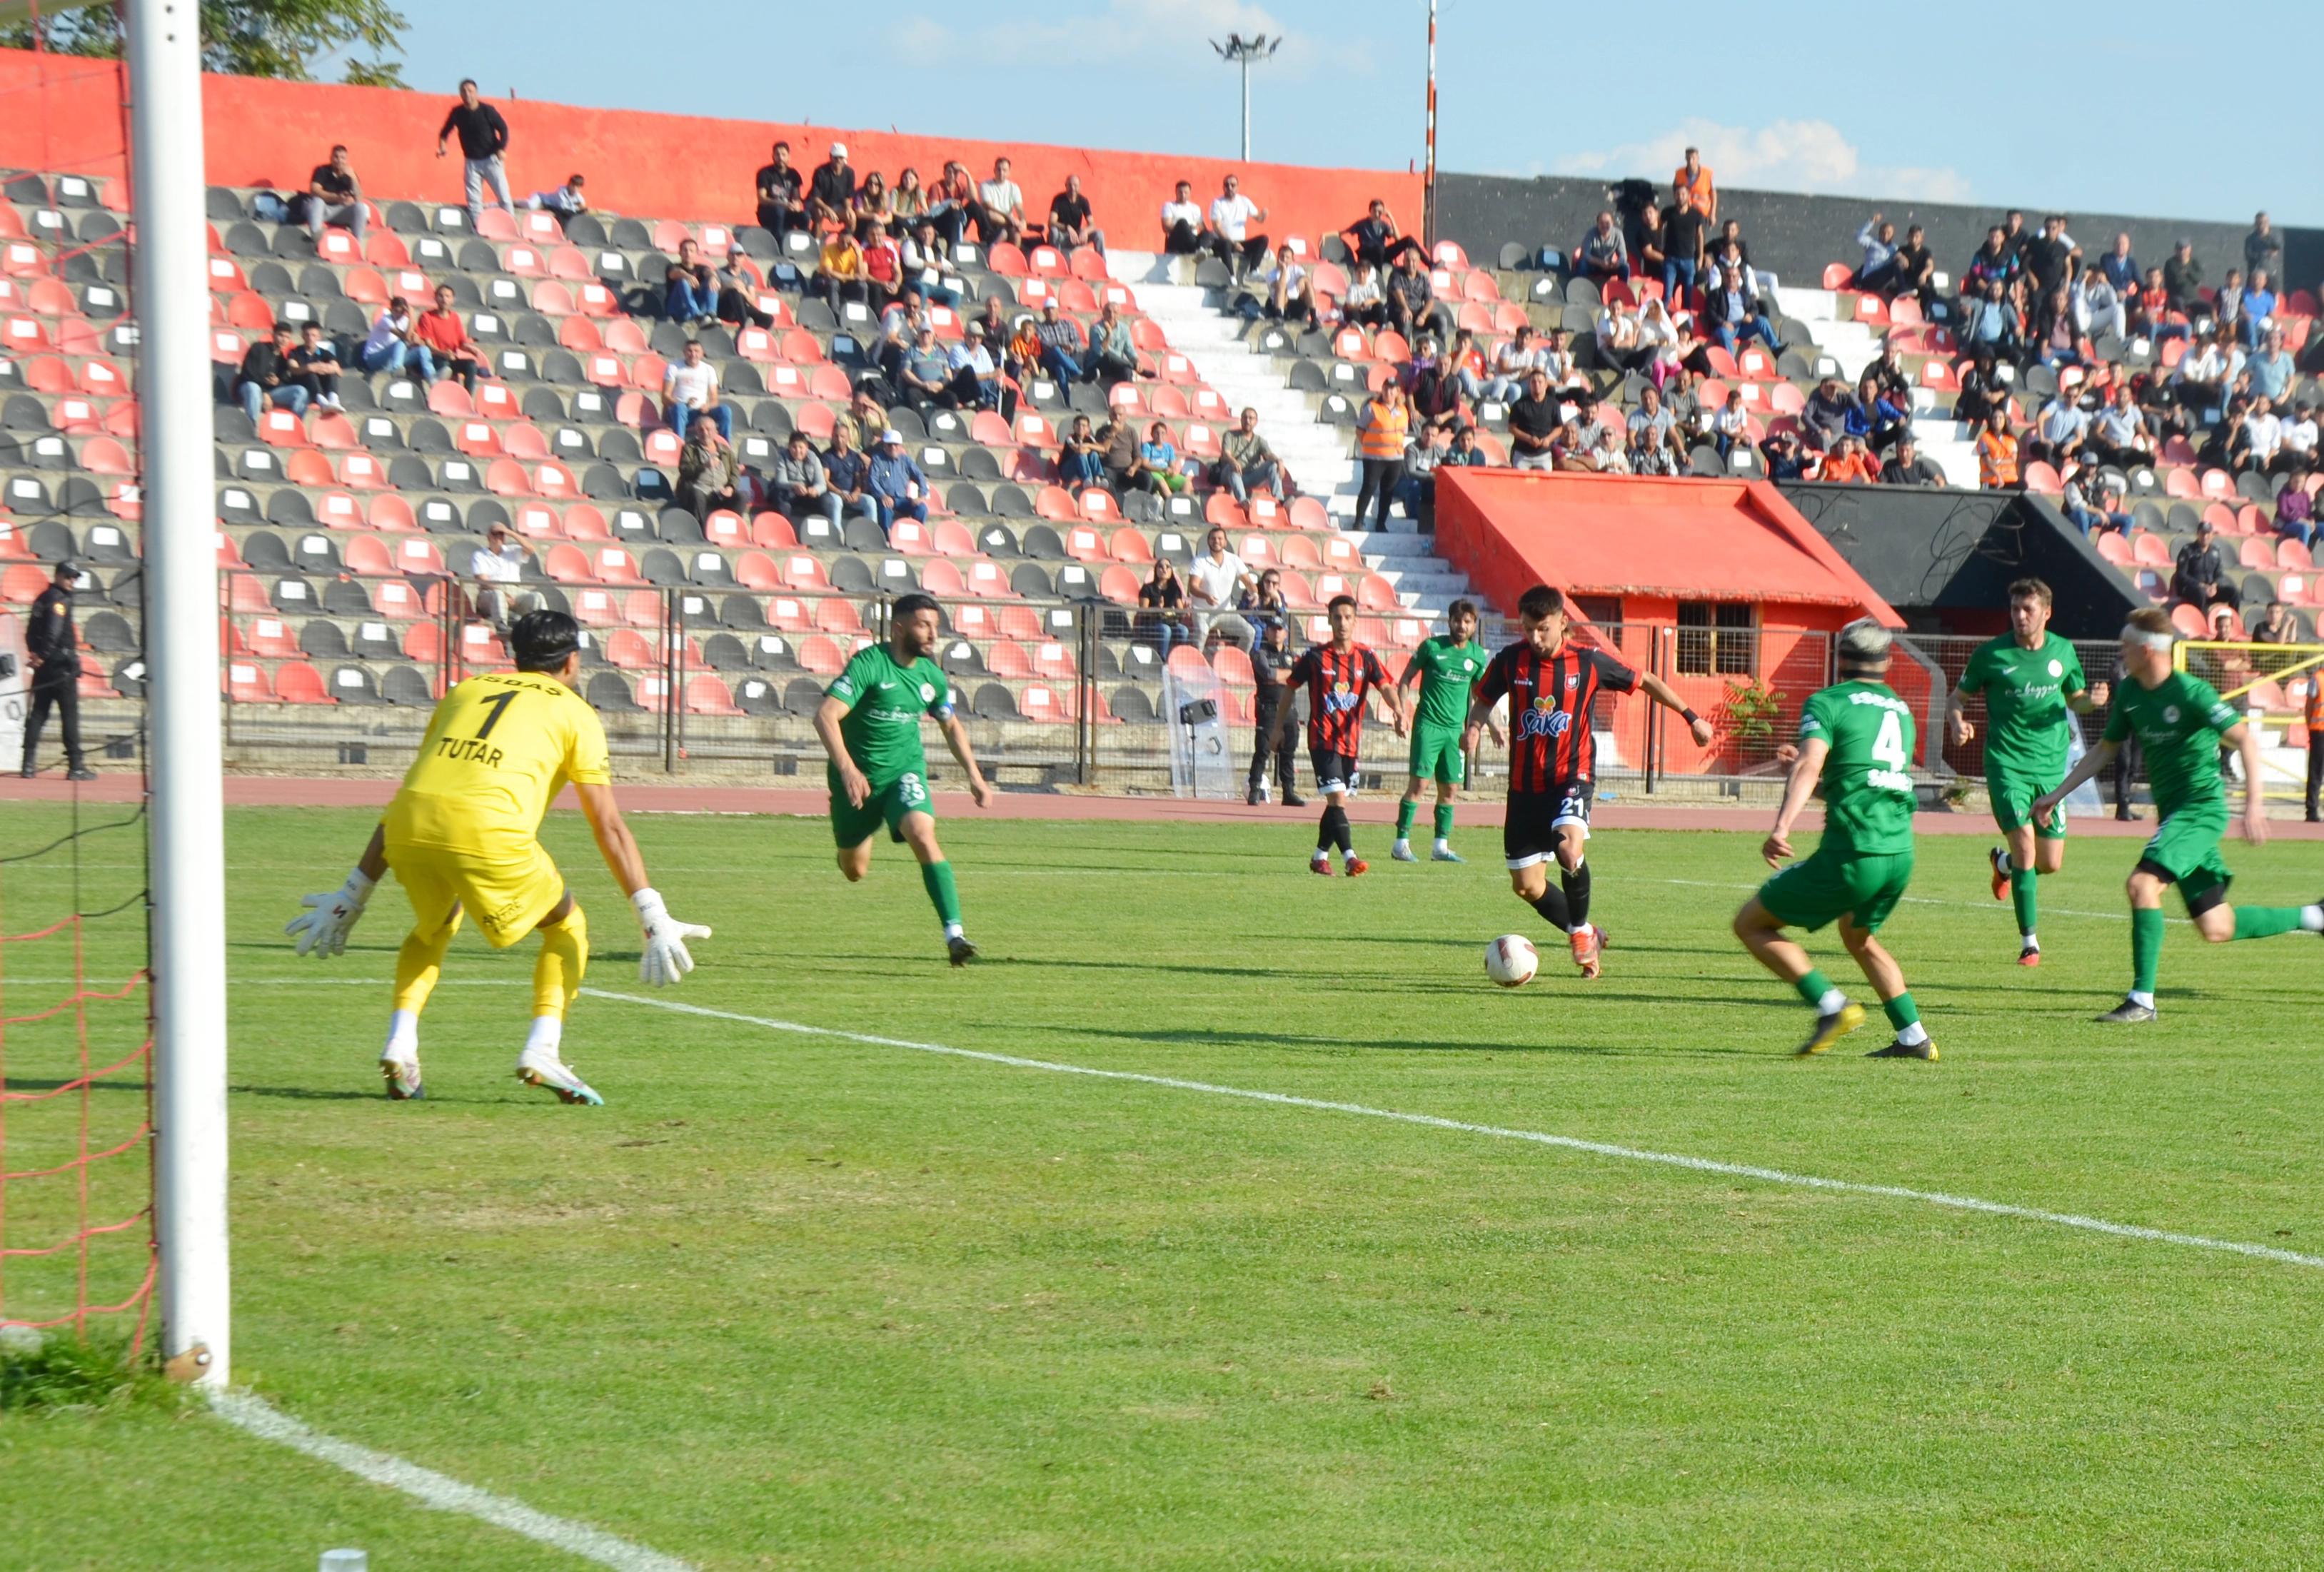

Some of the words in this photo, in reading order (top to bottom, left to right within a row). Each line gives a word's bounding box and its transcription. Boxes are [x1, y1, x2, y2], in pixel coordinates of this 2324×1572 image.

[475, 690, 521, 740] 1
[438, 737, 504, 769] TUTAR
[1871, 710, 1906, 772] 4
[1560, 797, 1584, 817] 21
